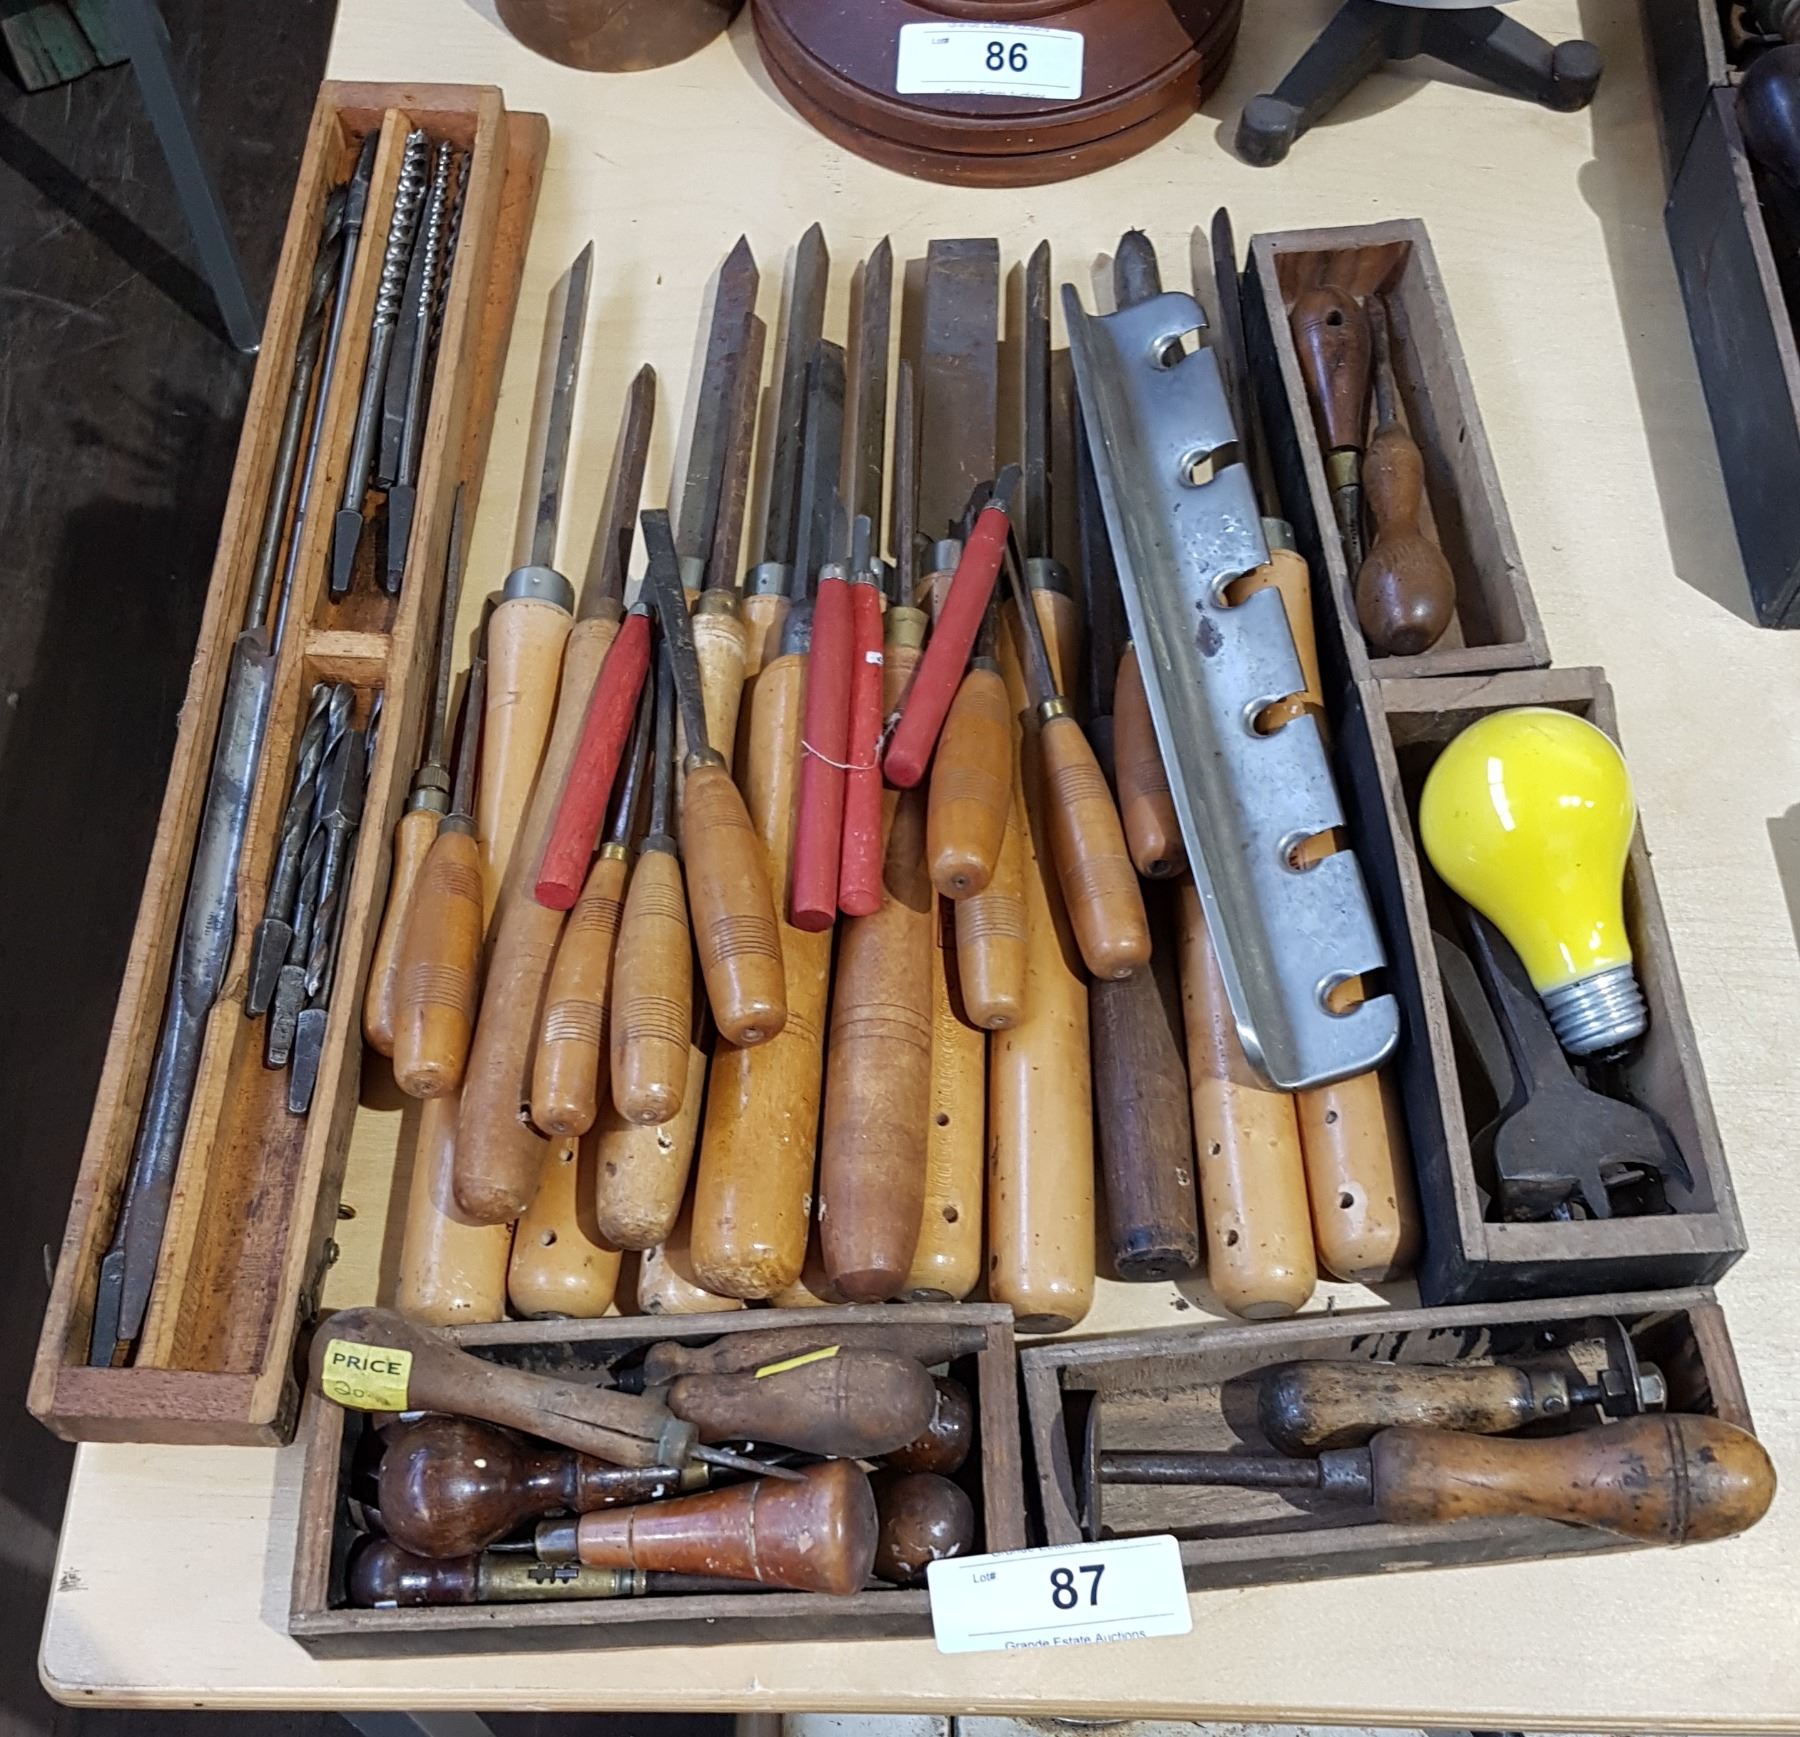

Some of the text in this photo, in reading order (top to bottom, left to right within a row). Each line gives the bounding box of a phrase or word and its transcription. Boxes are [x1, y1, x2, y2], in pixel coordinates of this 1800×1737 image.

[985, 40, 1029, 72] 86
[332, 1352, 403, 1376] PRICE
[972, 1563, 1106, 1610] Lot# 87
